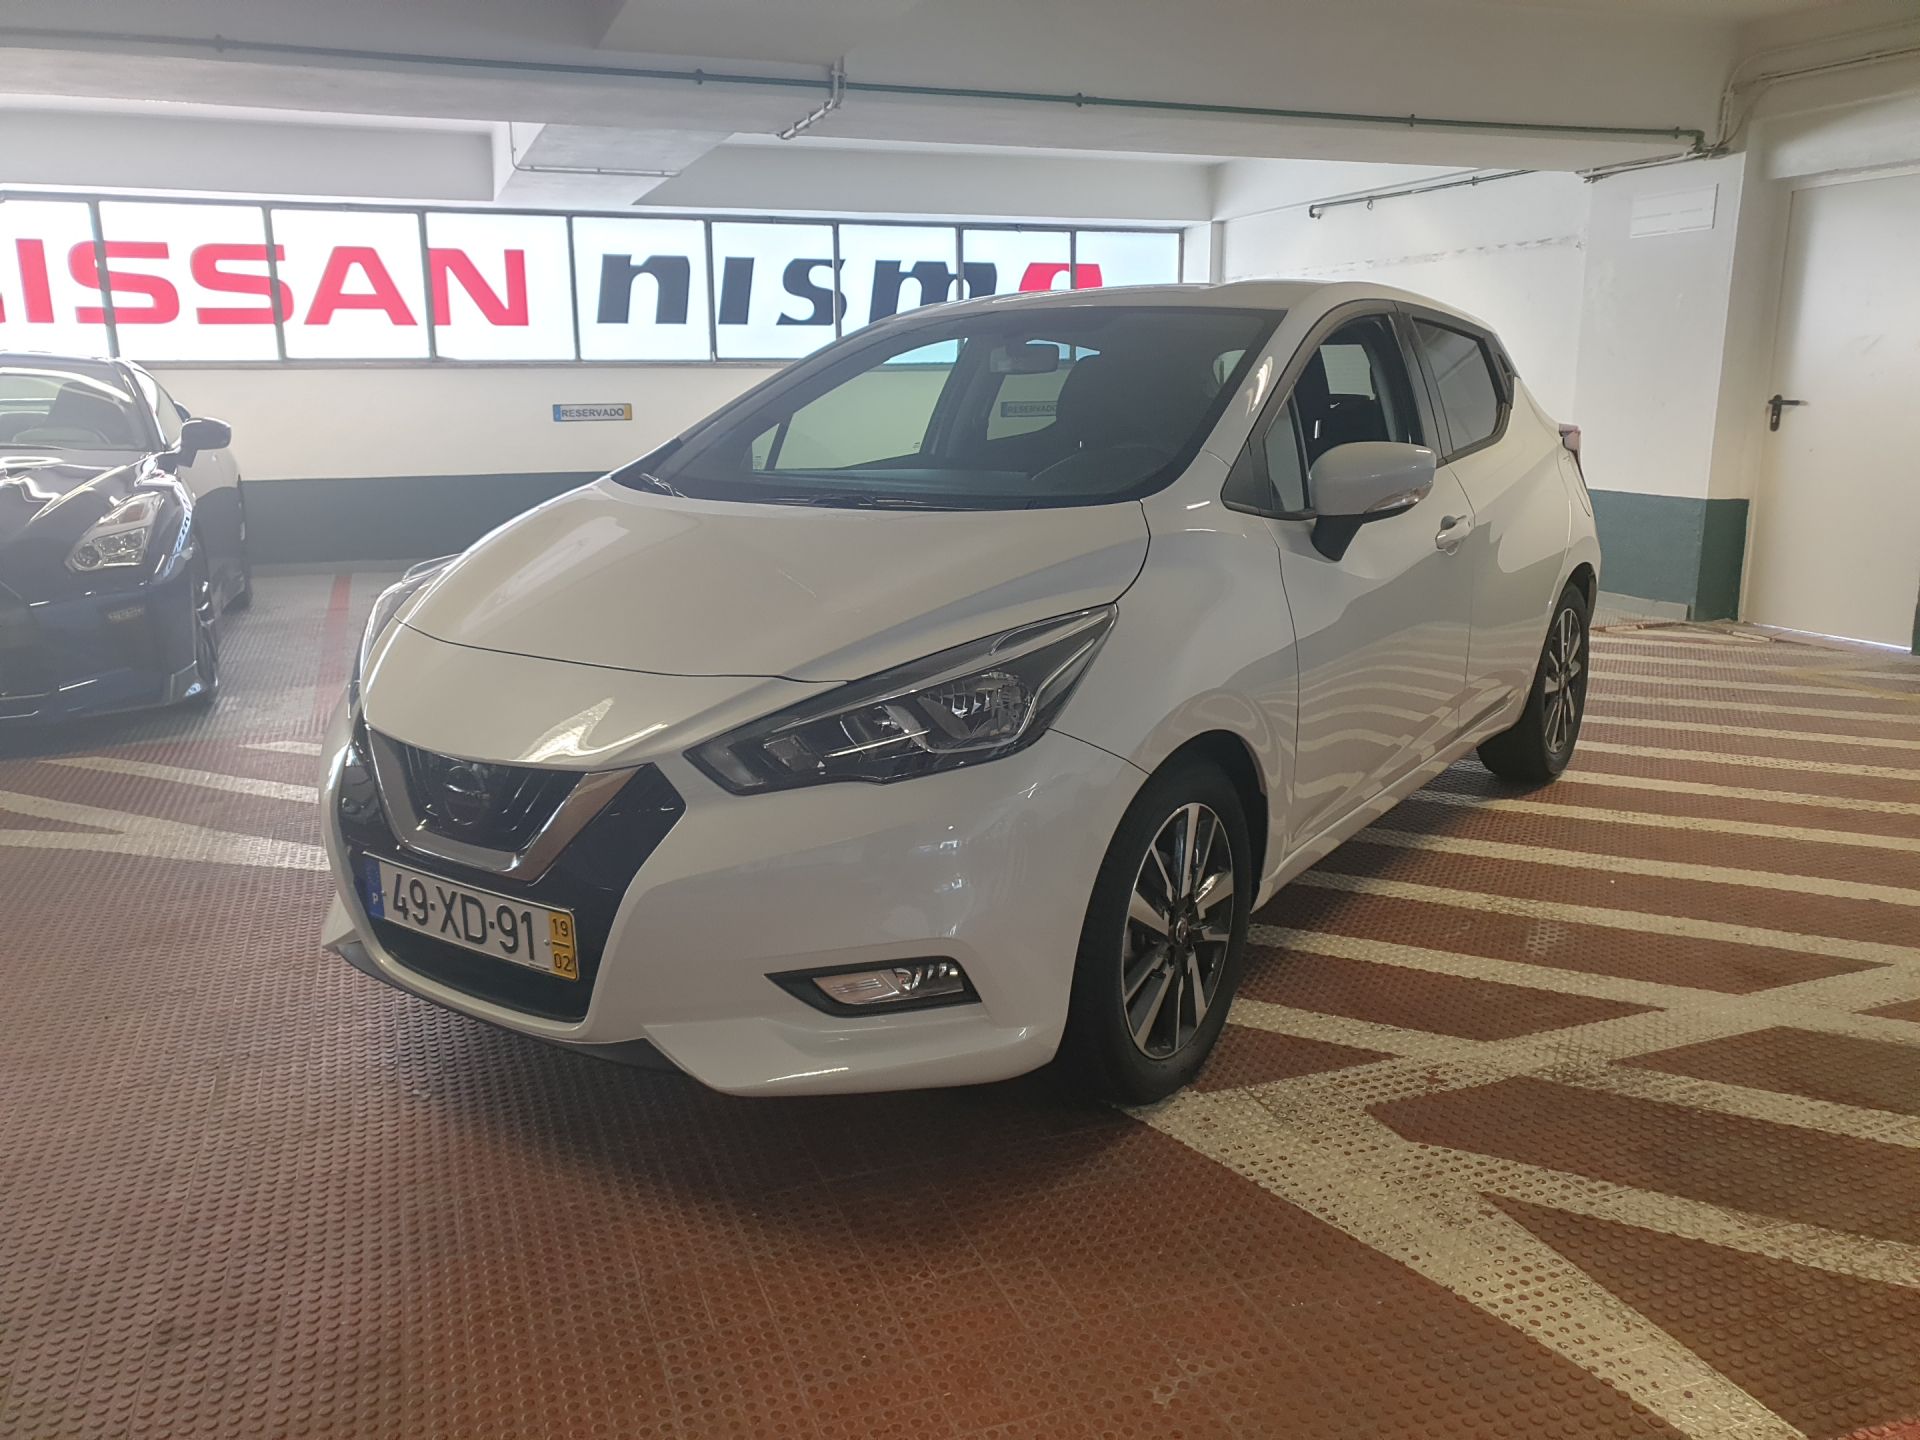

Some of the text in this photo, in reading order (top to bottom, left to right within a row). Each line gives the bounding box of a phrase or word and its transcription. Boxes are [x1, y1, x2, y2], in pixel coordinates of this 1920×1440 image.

[0, 238, 530, 327] ISSAN
[561, 408, 624, 418] RESERVADO
[552, 918, 569, 937] 19
[554, 952, 572, 972] 02
